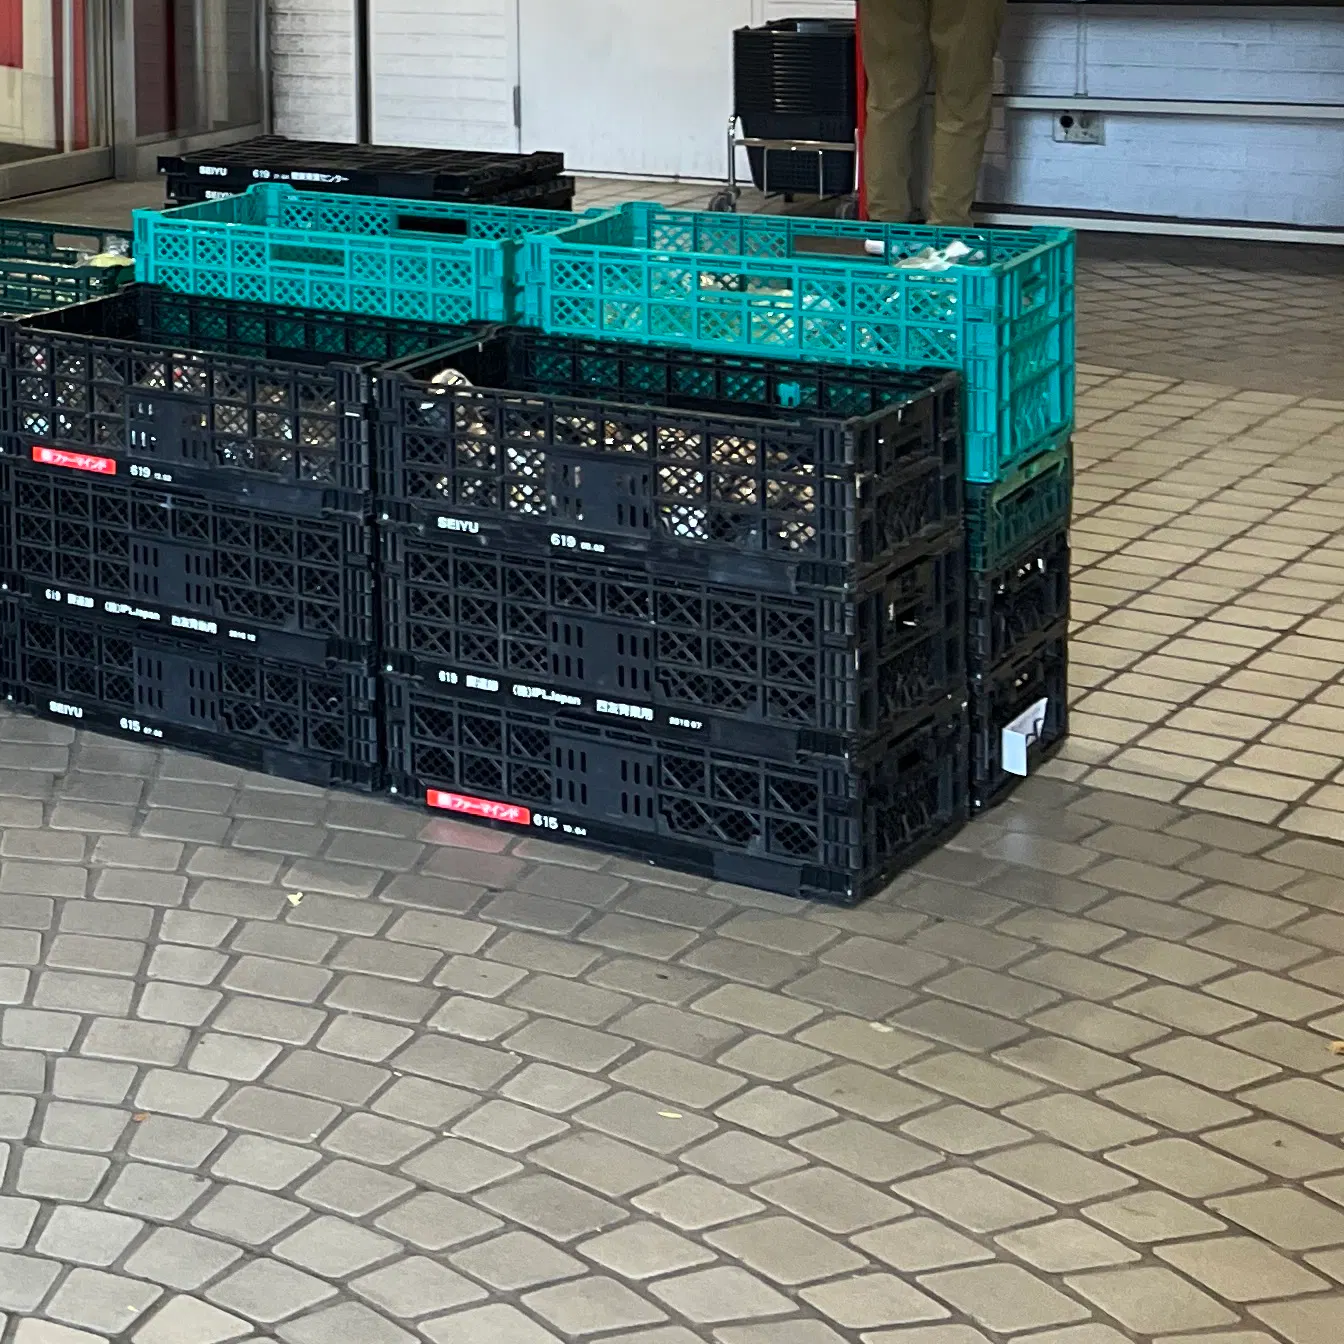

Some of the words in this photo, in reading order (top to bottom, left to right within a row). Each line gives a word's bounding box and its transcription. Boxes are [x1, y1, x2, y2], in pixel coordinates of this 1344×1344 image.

[198, 165, 228, 177] SEIYU
[205, 189, 234, 200] SEIY
[437, 516, 480, 534] SEIYU
[49, 700, 83, 718] SEIYU
[119, 717, 141, 732] 615
[533, 813, 559, 830] 615
